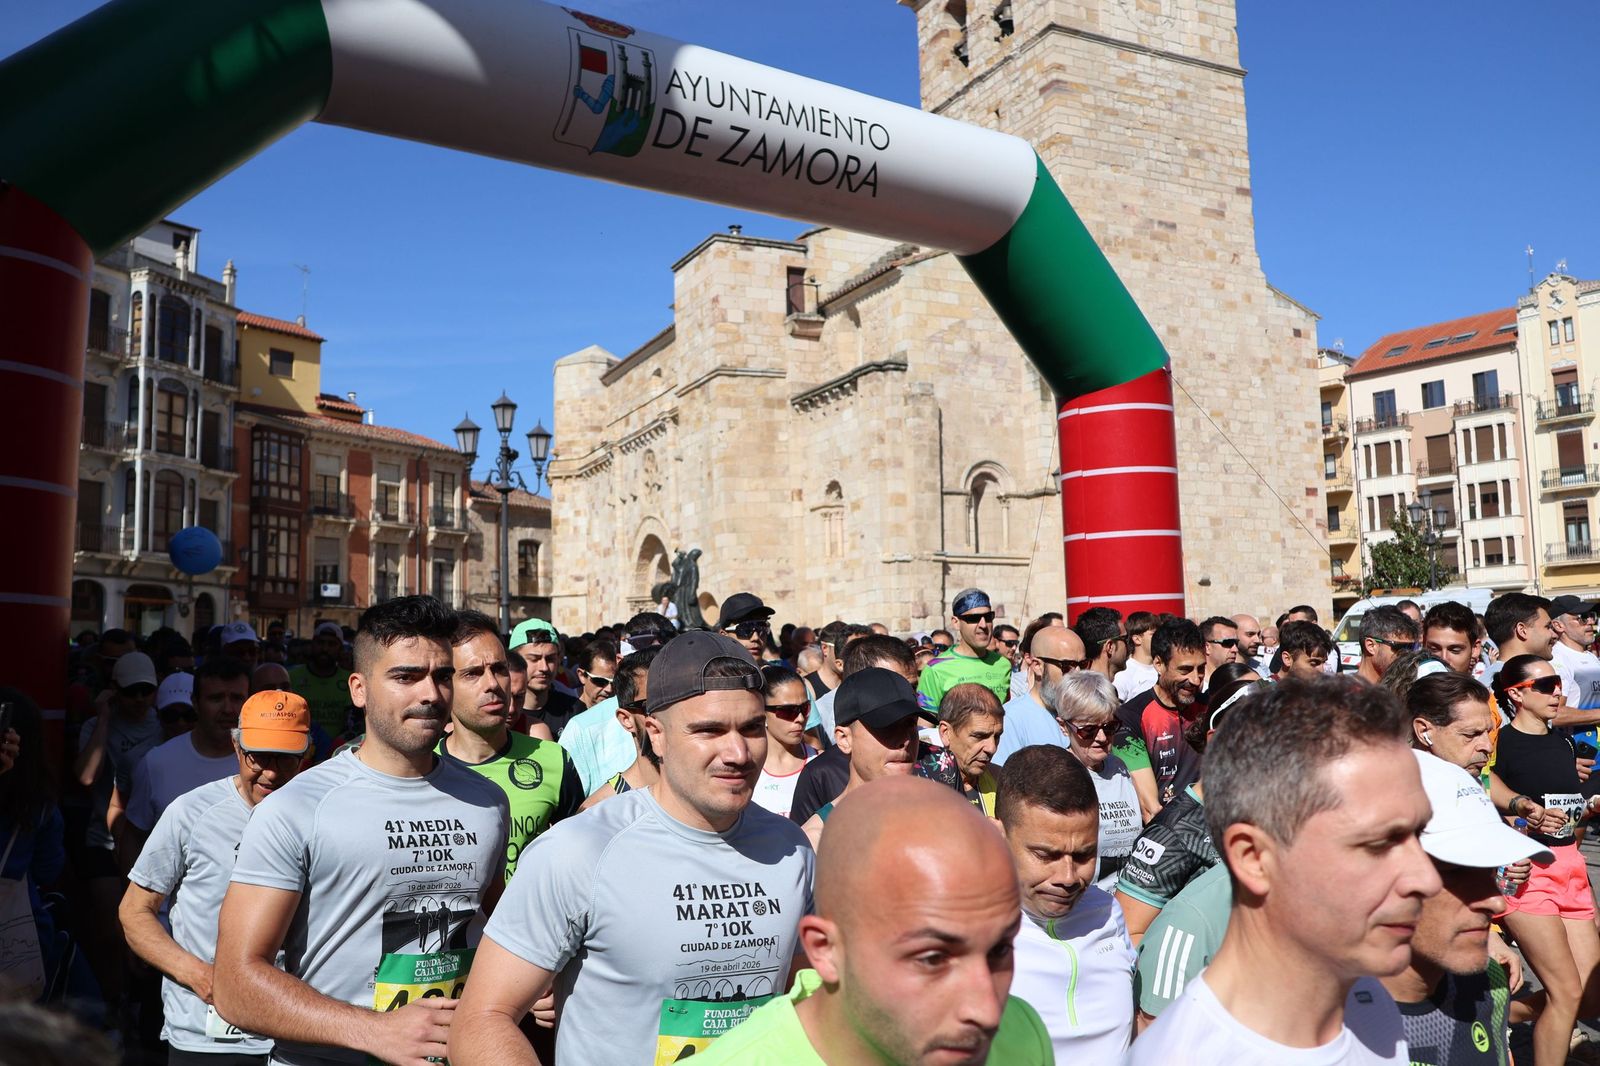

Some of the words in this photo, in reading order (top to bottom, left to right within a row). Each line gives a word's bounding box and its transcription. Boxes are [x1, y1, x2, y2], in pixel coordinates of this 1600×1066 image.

[665, 68, 890, 151] AYUNTAMIENTO
[651, 108, 714, 158] DE
[717, 125, 880, 198] ZAMORA
[1108, 801, 1130, 810] MEDIA
[1549, 798, 1561, 806] 10K
[409, 818, 465, 832] MEDIA
[1119, 819, 1131, 827] 10K
[427, 848, 454, 862] 10K
[390, 865, 424, 875] CIUDAD
[437, 863, 474, 872] ZAMORA
[408, 884, 416, 892] 19
[701, 882, 767, 900] MEDIA
[721, 920, 754, 937] 10K
[680, 942, 719, 953] CIUDAD
[734, 937, 776, 949] ZAMORA
[414, 968, 435, 977] CAJA
[437, 963, 460, 974] RURAL
[701, 965, 710, 973] 19
[711, 963, 720, 972] de
[722, 962, 740, 971] abril
[742, 961, 761, 970] 2026
[703, 1019, 728, 1029] CAJA
